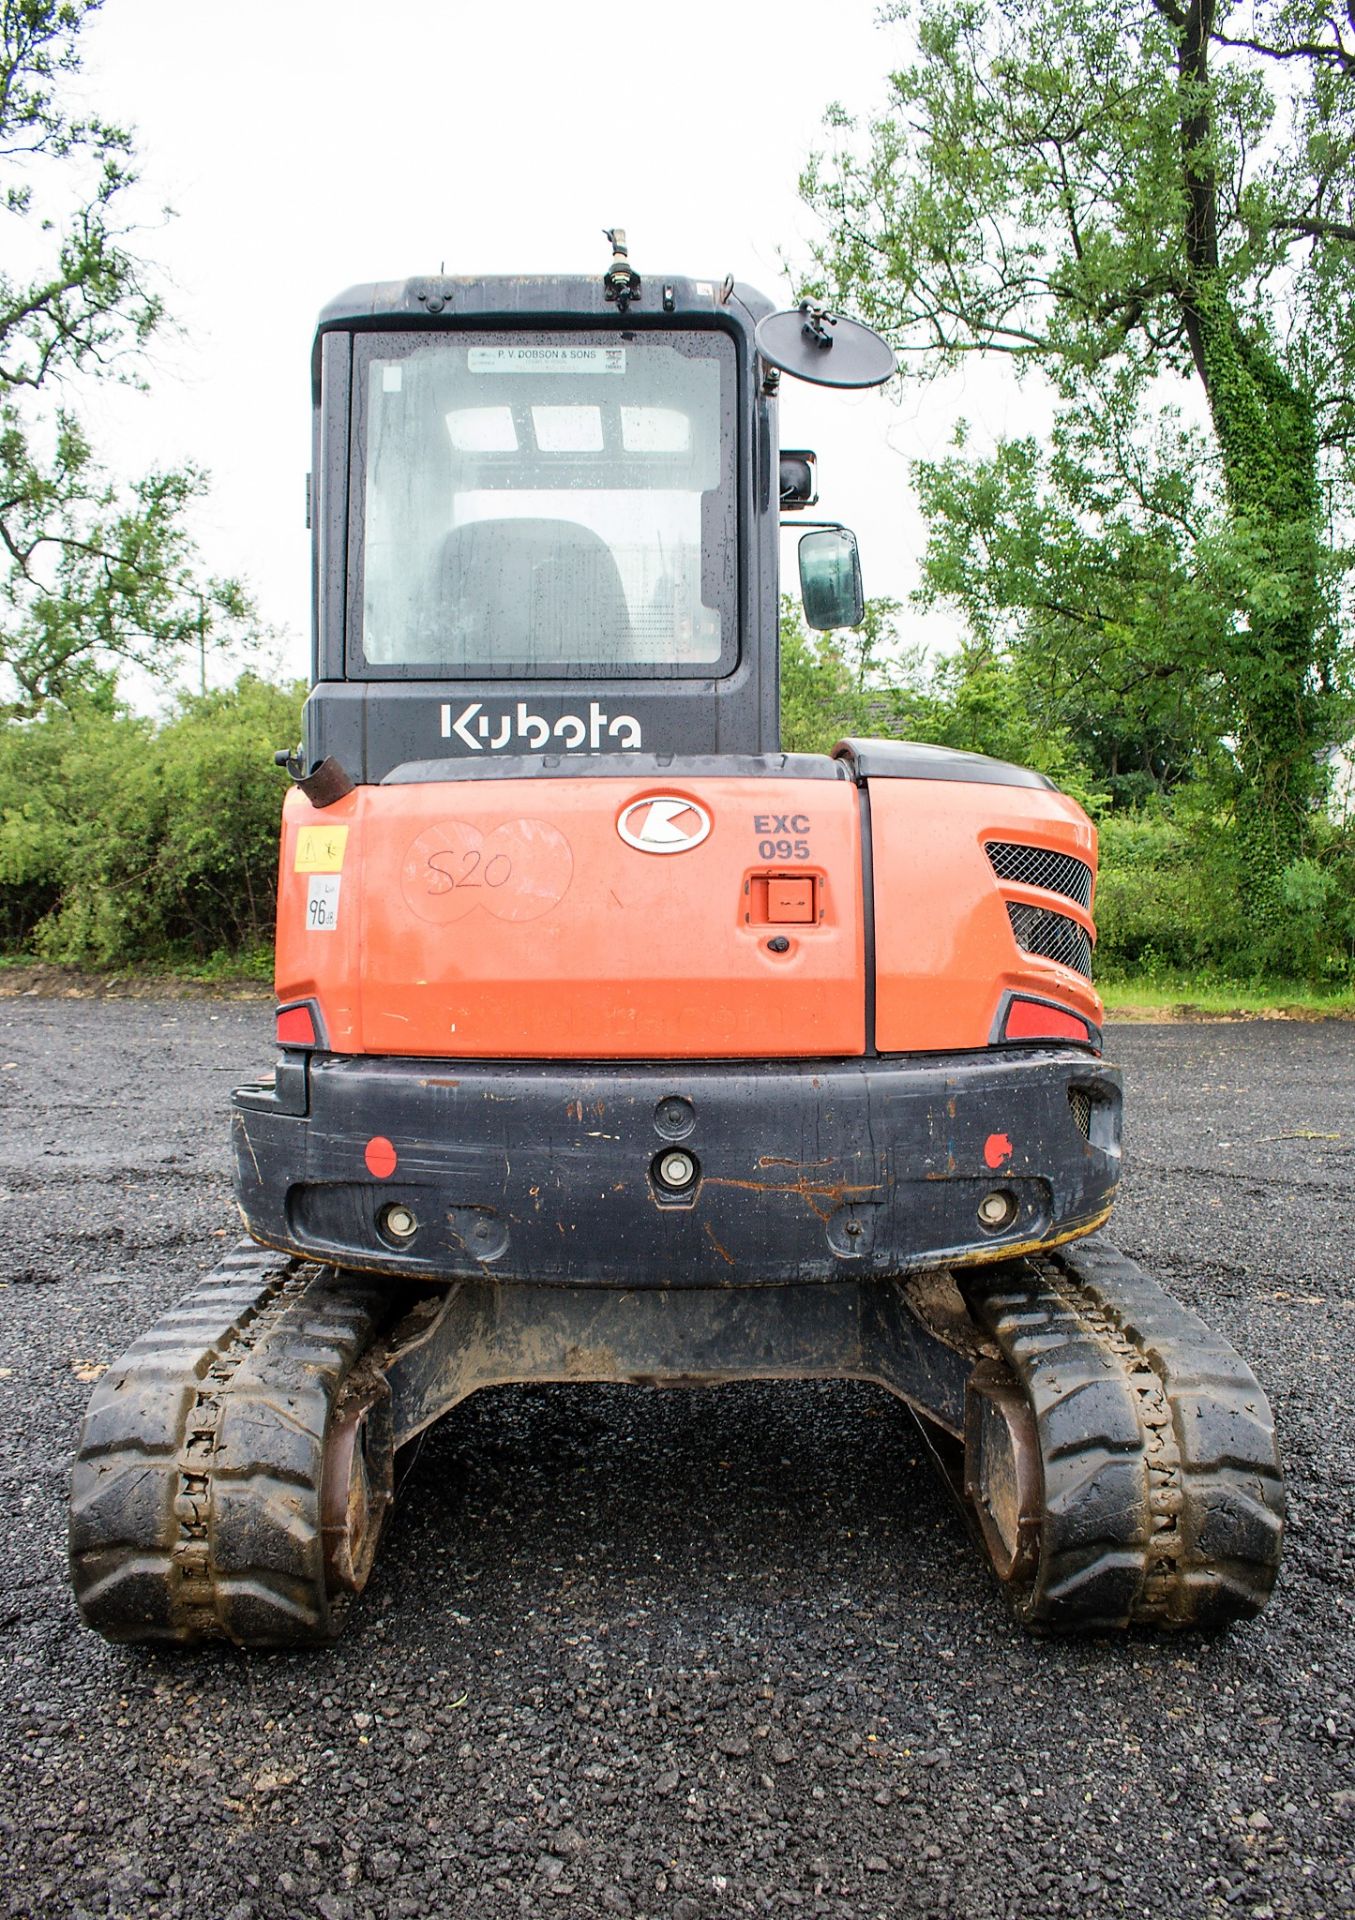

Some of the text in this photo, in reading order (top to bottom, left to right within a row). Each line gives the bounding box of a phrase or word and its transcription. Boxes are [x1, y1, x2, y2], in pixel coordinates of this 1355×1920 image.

[498, 351, 506, 359] P.
[508, 351, 516, 359] V.
[518, 350, 559, 359] DOBSON
[561, 351, 568, 359] &
[570, 351, 597, 359] SONS
[440, 702, 642, 750] Kubota
[753, 815, 810, 834] EXC
[758, 840, 810, 859] 095
[427, 850, 512, 895] S20
[309, 899, 327, 925] 96
